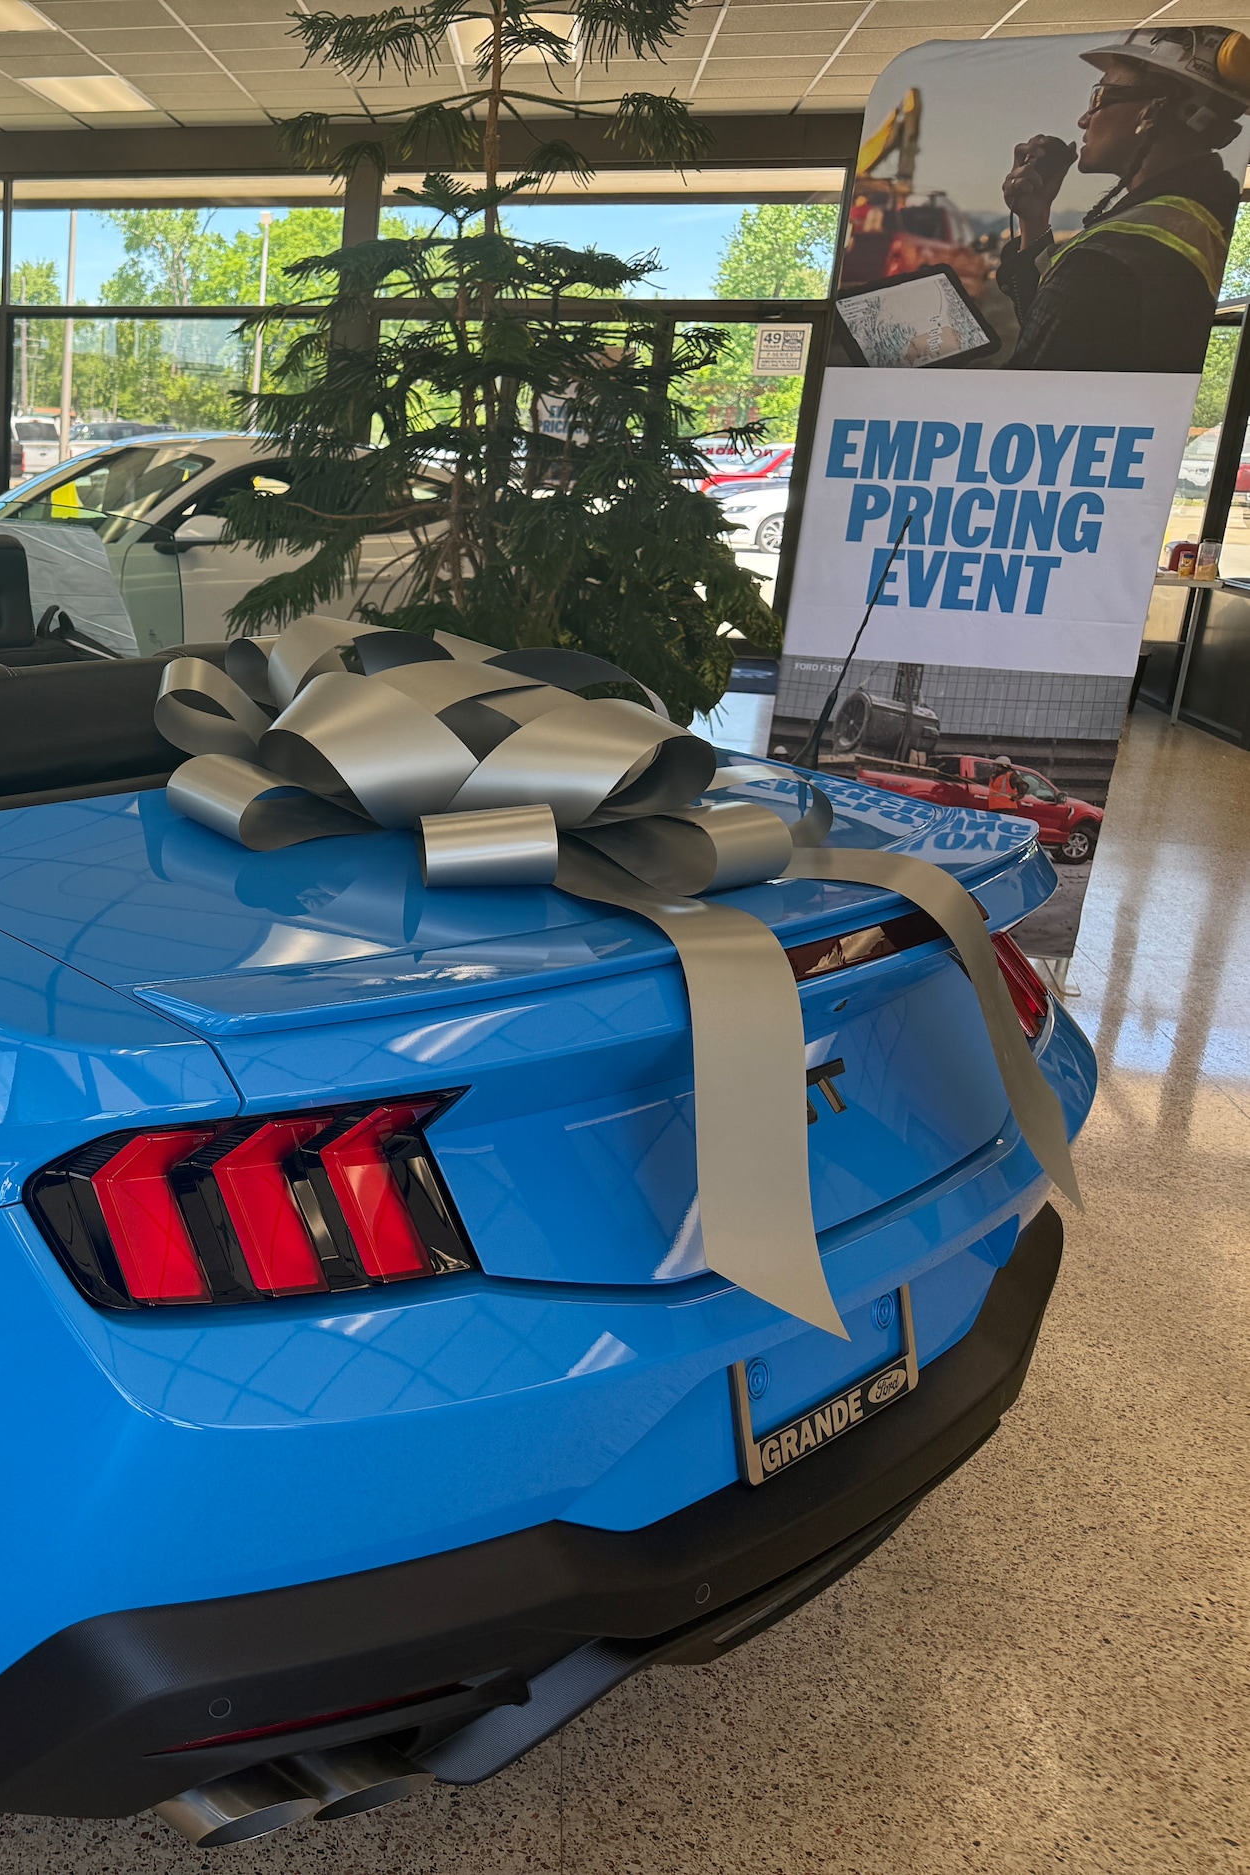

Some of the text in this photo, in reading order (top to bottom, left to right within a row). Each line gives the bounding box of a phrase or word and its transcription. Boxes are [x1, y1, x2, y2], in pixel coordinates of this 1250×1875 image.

[763, 332, 782, 344] 49
[825, 418, 1154, 489] EMPLOYEE
[845, 484, 1105, 553] PRICING
[865, 547, 1062, 615] EVENT
[794, 662, 843, 673] FORD F-150
[806, 1057, 847, 1126] T
[762, 1373, 900, 1472] GRANDE Ford
